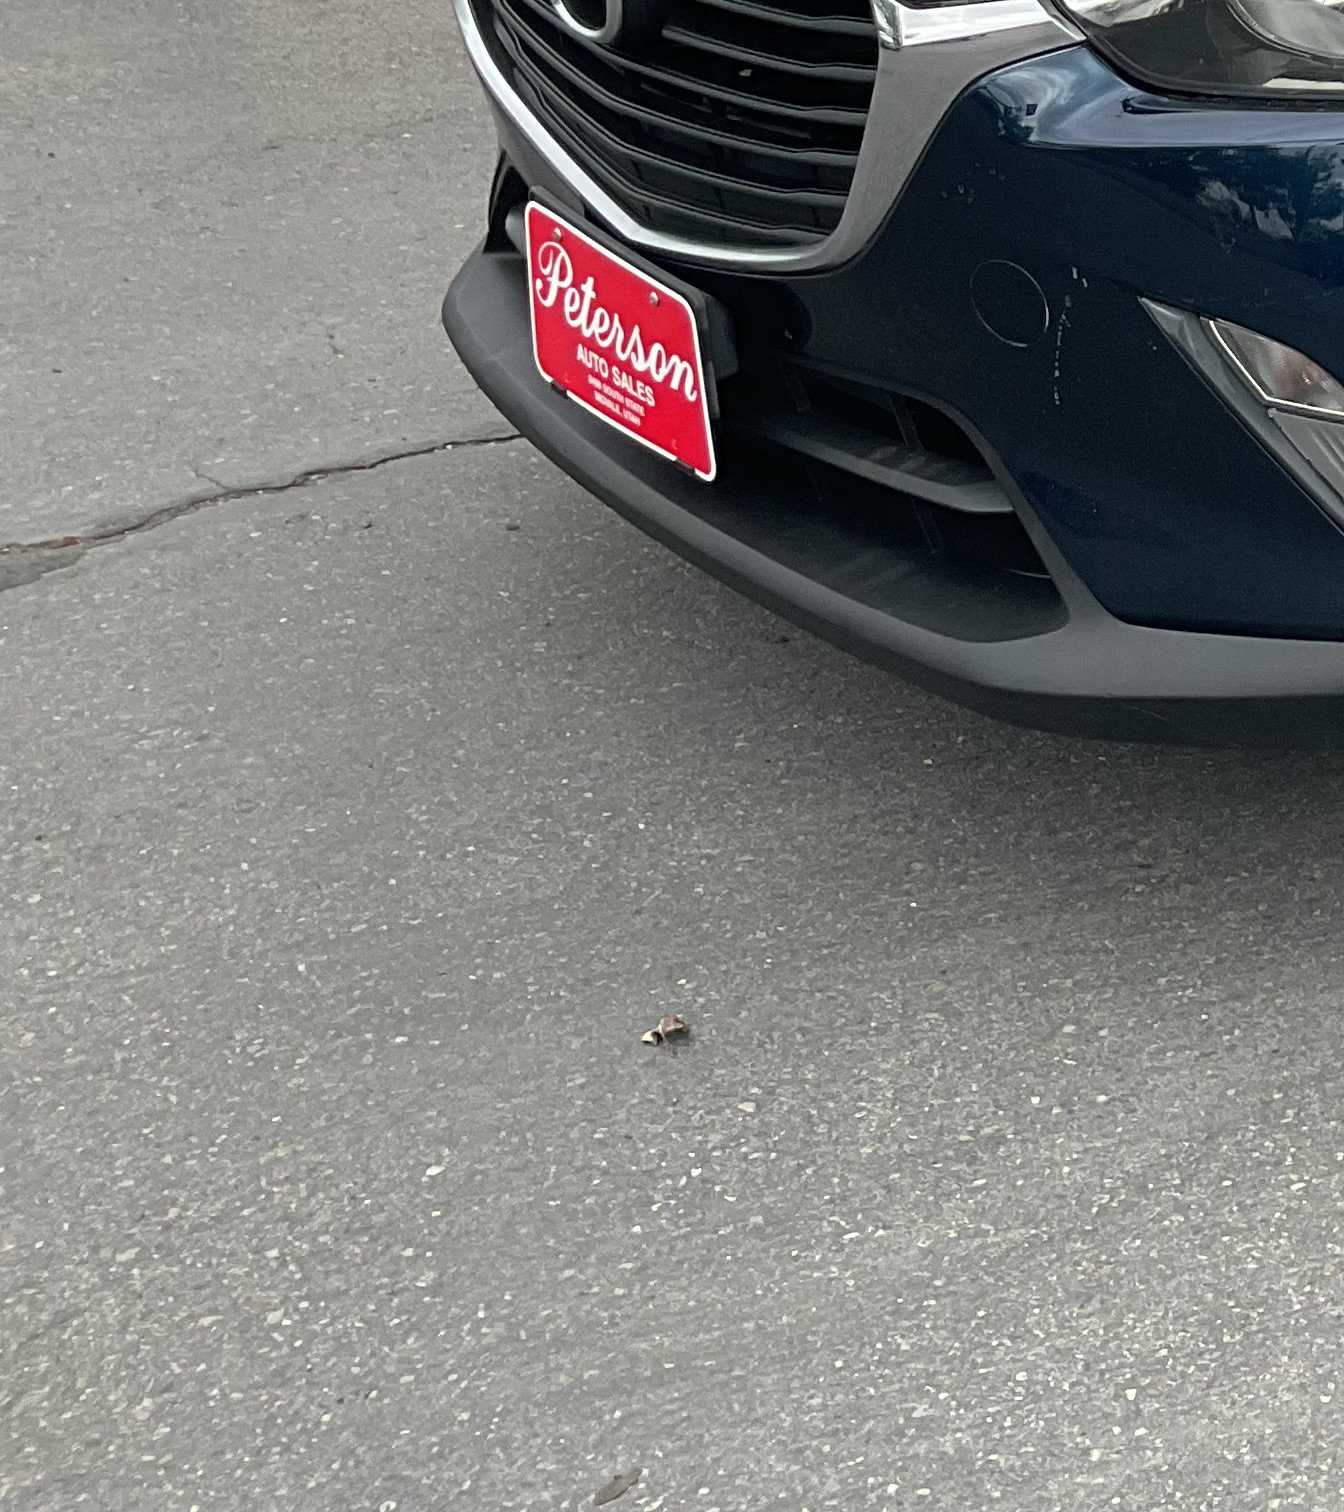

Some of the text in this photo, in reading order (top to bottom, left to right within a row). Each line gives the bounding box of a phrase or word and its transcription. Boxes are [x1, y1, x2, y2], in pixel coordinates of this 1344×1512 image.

[535, 241, 697, 402] Peterson
[577, 343, 609, 379] AUTO
[611, 365, 656, 407] SALES
